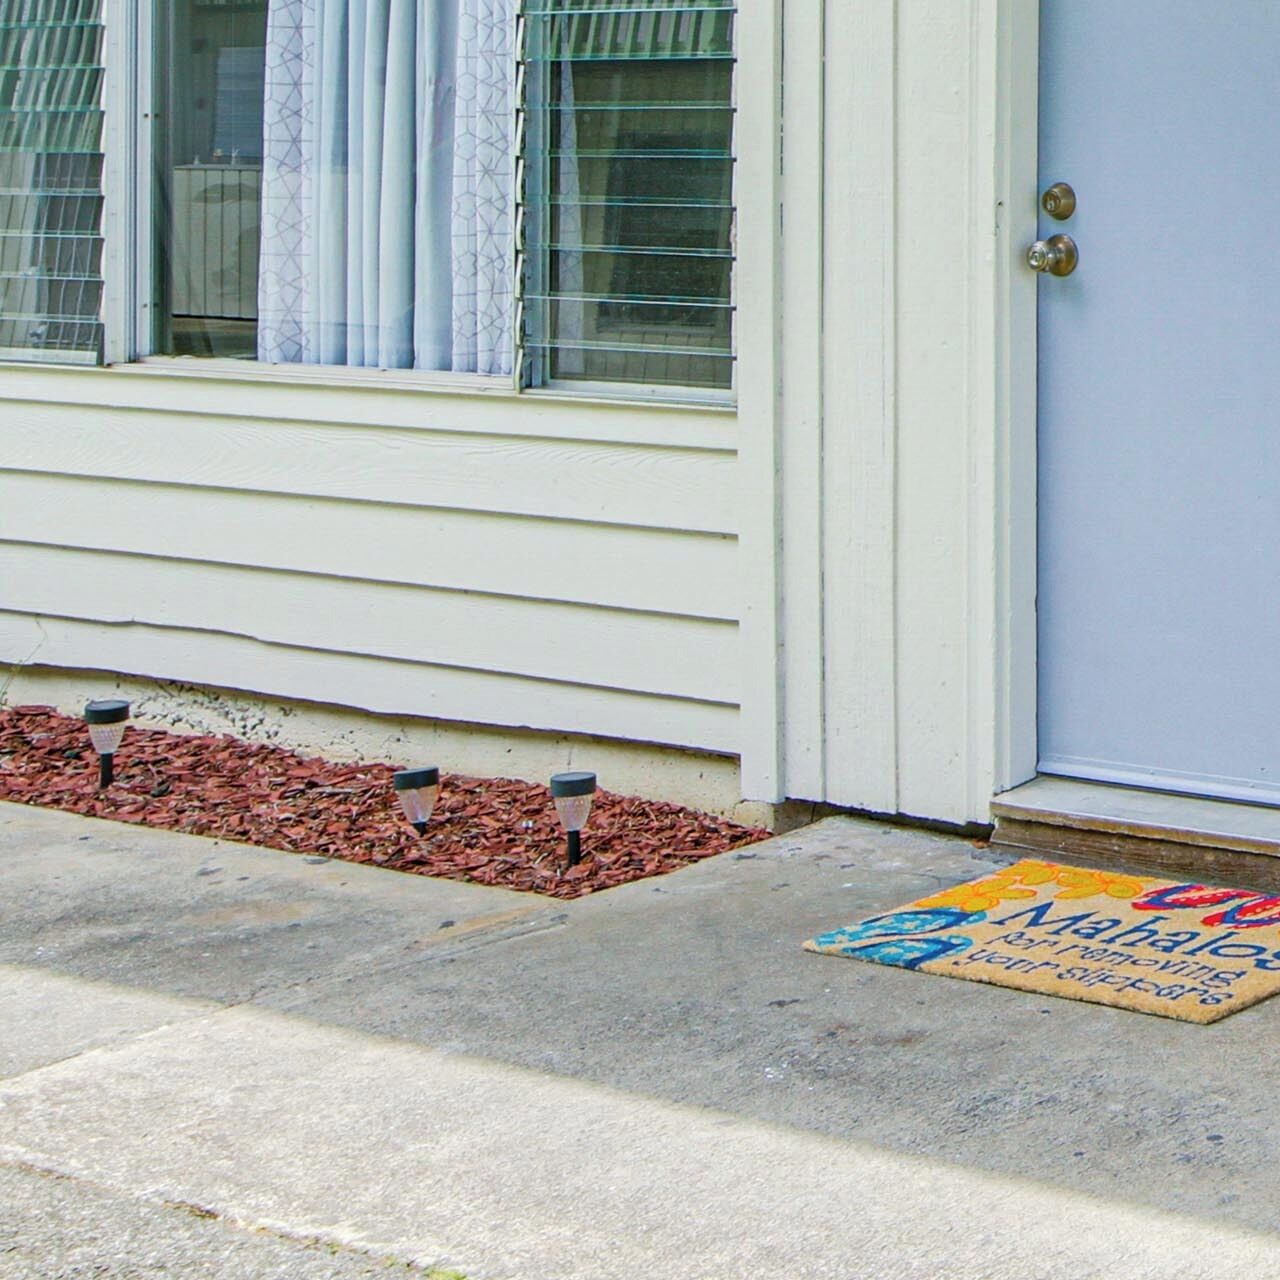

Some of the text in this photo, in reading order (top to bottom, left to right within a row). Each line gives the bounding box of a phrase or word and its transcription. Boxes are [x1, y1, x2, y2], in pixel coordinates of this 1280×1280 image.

[952, 948, 1236, 1005] your slippers
[984, 931, 1252, 988] for removing
